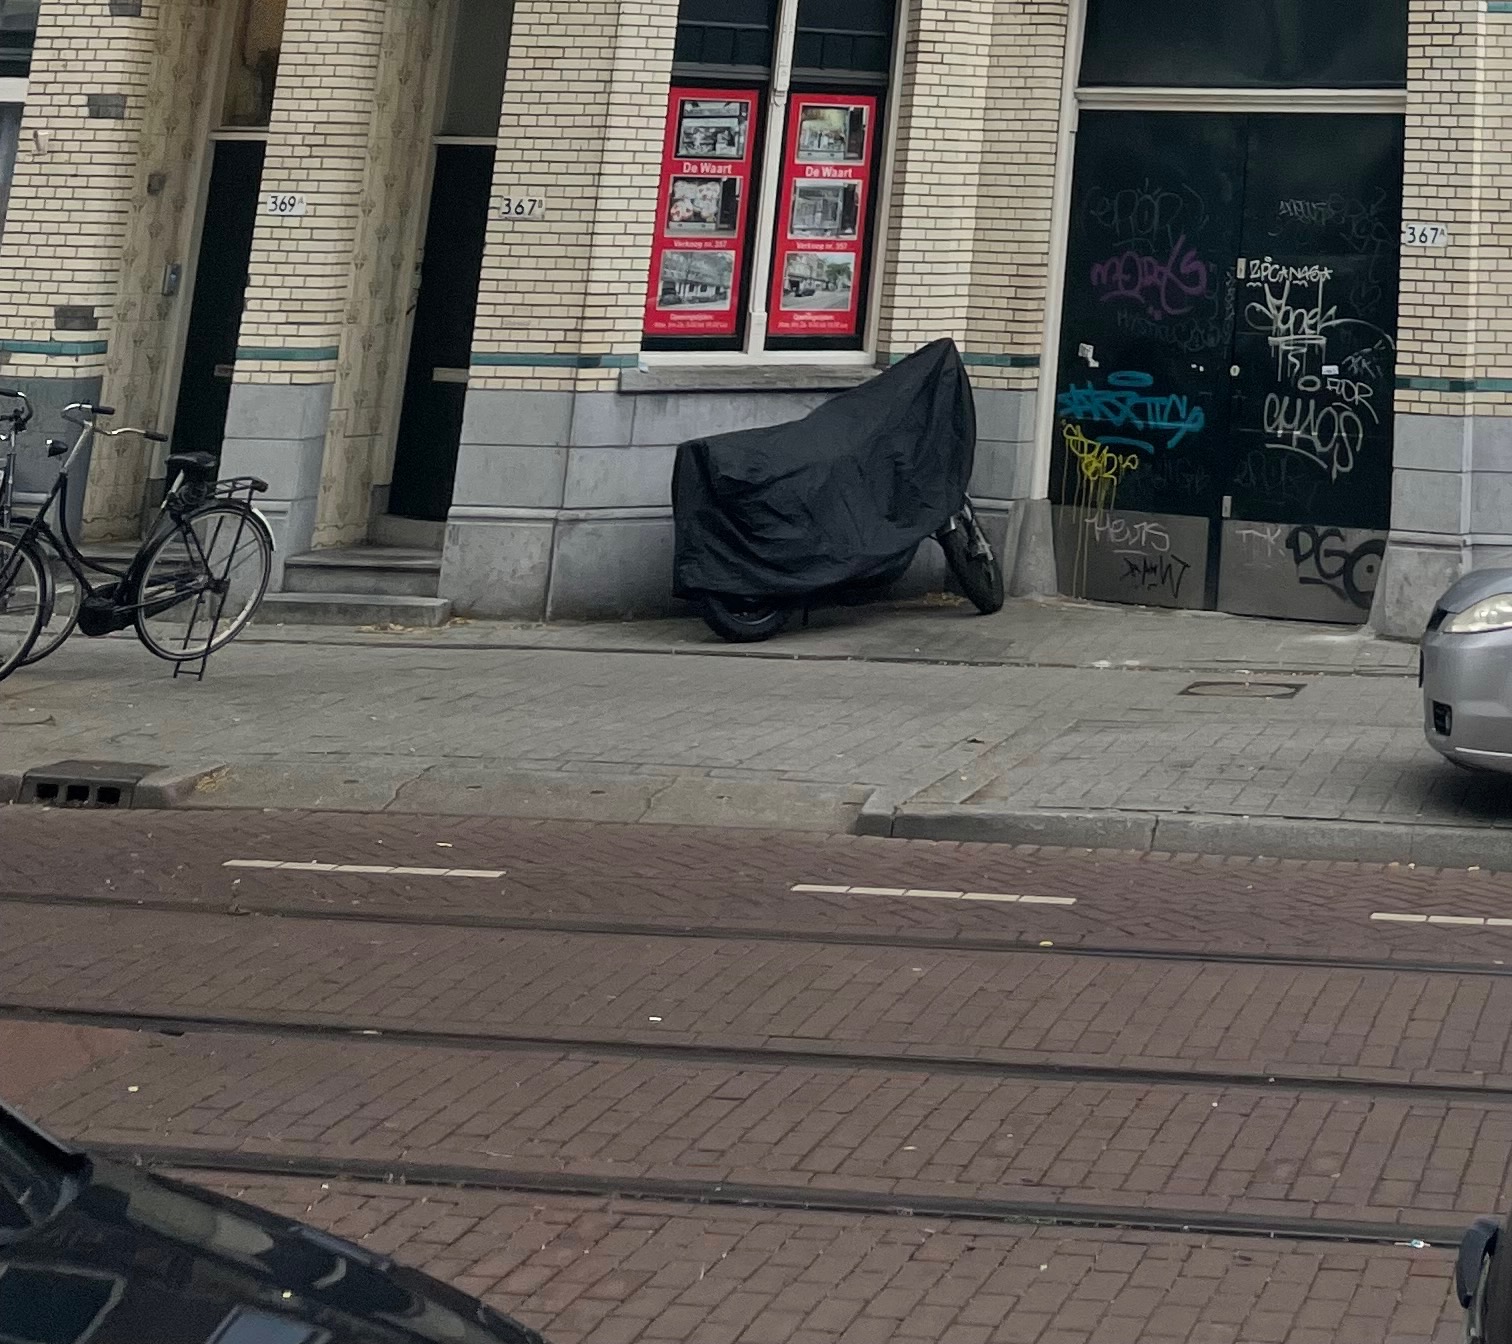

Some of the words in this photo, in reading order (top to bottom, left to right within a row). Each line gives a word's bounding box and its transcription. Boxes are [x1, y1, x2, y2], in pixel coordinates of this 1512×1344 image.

[682, 161, 698, 174] De
[700, 162, 732, 174] Waart
[805, 165, 820, 178] De
[821, 166, 852, 178] Waart
